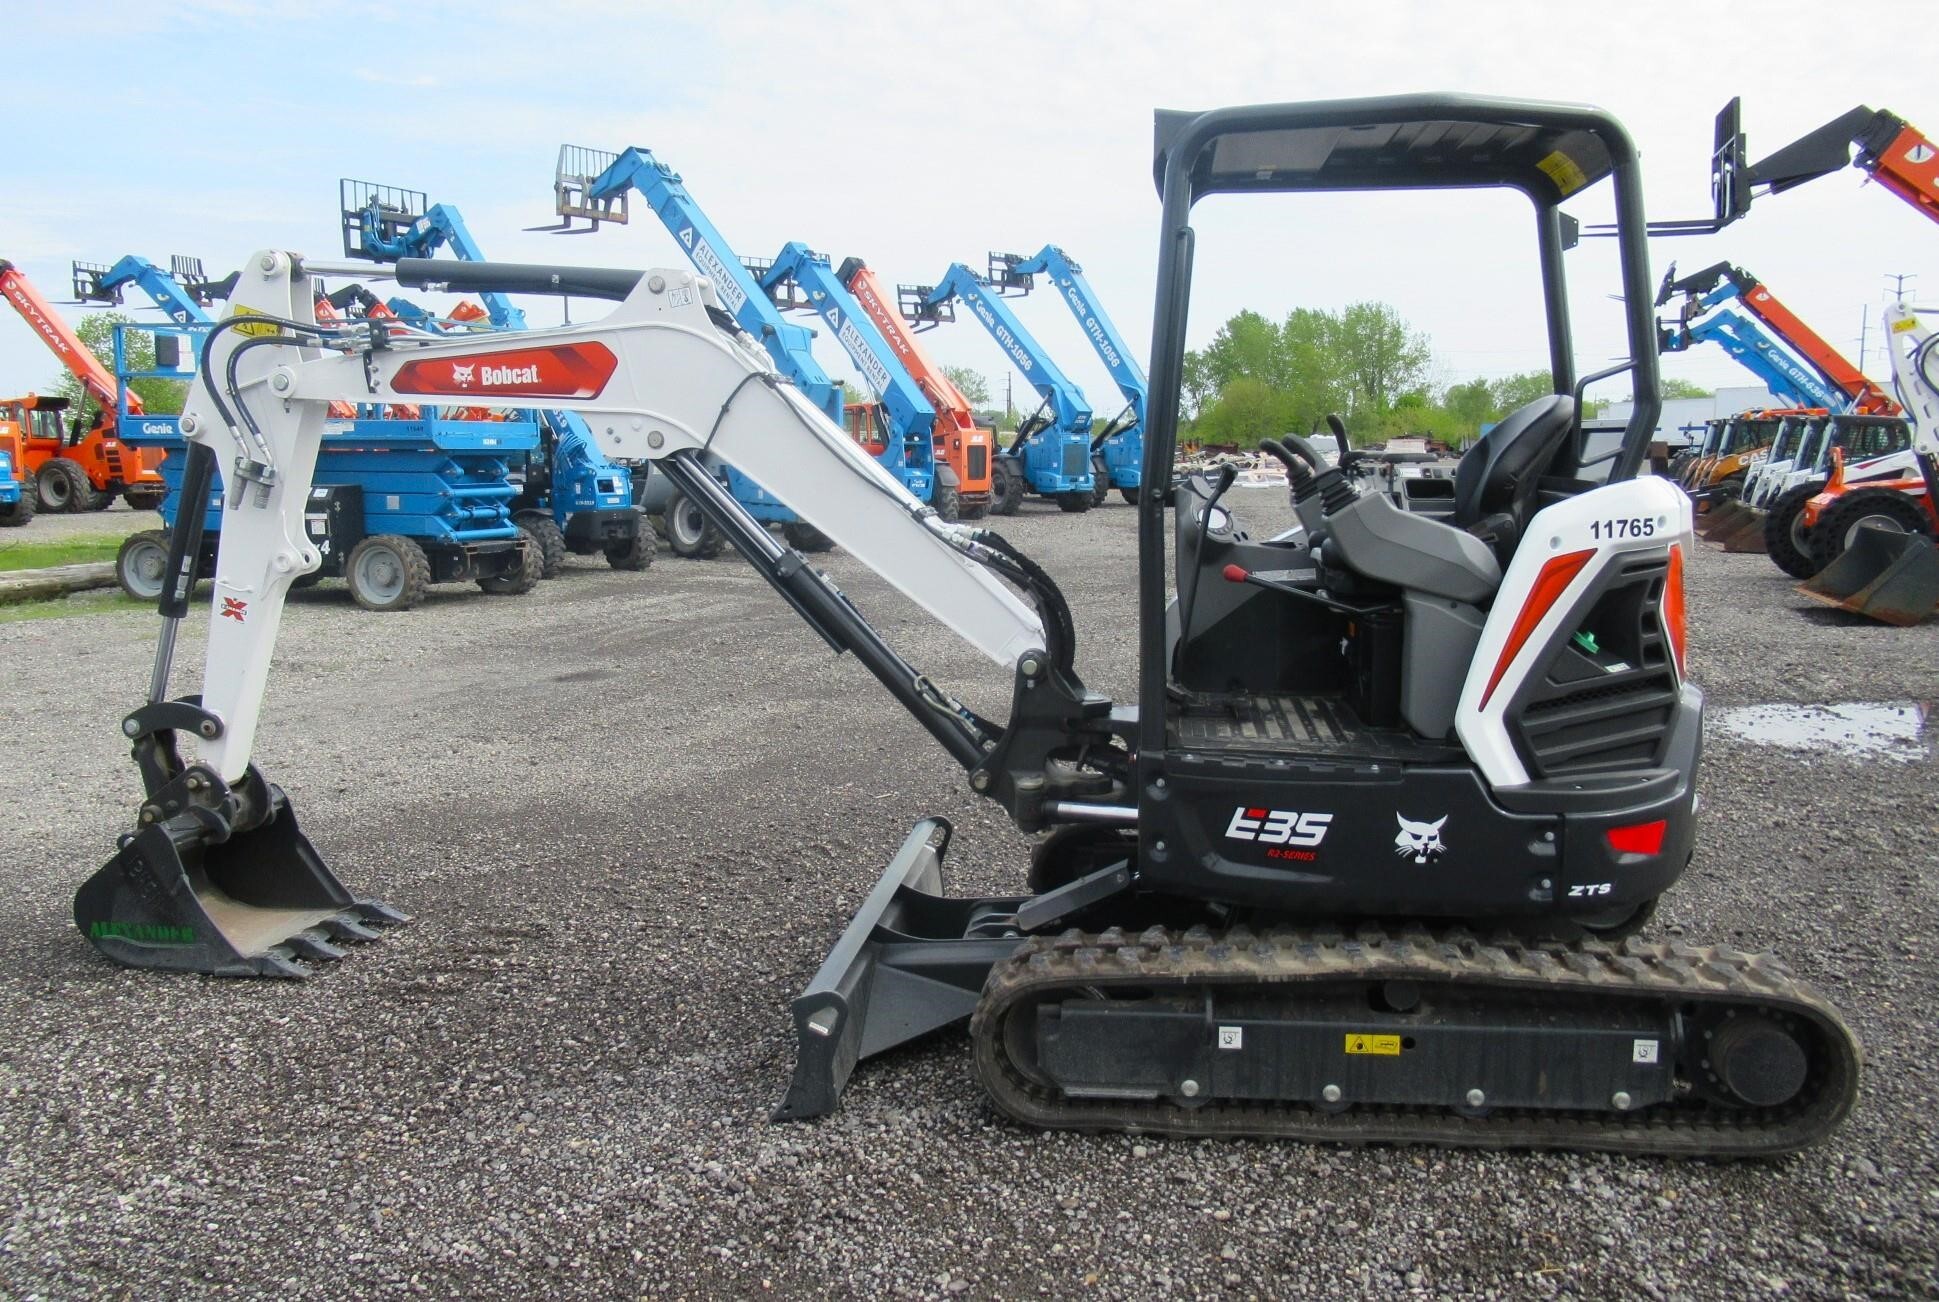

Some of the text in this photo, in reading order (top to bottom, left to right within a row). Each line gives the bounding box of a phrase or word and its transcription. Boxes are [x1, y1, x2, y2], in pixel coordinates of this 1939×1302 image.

[695, 252, 738, 308] EQUIPMENT RENTAL
[699, 245, 743, 300] ALEXANDER
[14, 291, 69, 353] SKYTRAK
[864, 291, 909, 354] SKYTRAK
[976, 301, 1032, 371] Genie GTH-1056
[1068, 287, 1120, 368] Genie GTH-1056
[481, 365, 538, 386] Bobcat
[842, 330, 883, 387] EQUIPMENT RENTAL
[845, 325, 887, 382] ALEXANDER
[1768, 349, 1789, 371] Genie
[143, 423, 173, 434] Genie
[1738, 448, 1769, 466] CAS
[1590, 517, 1654, 540] 11765
[1225, 807, 1334, 847] E35
[1266, 848, 1316, 862] R2-SERIES
[1568, 883, 1612, 896] ZTS
